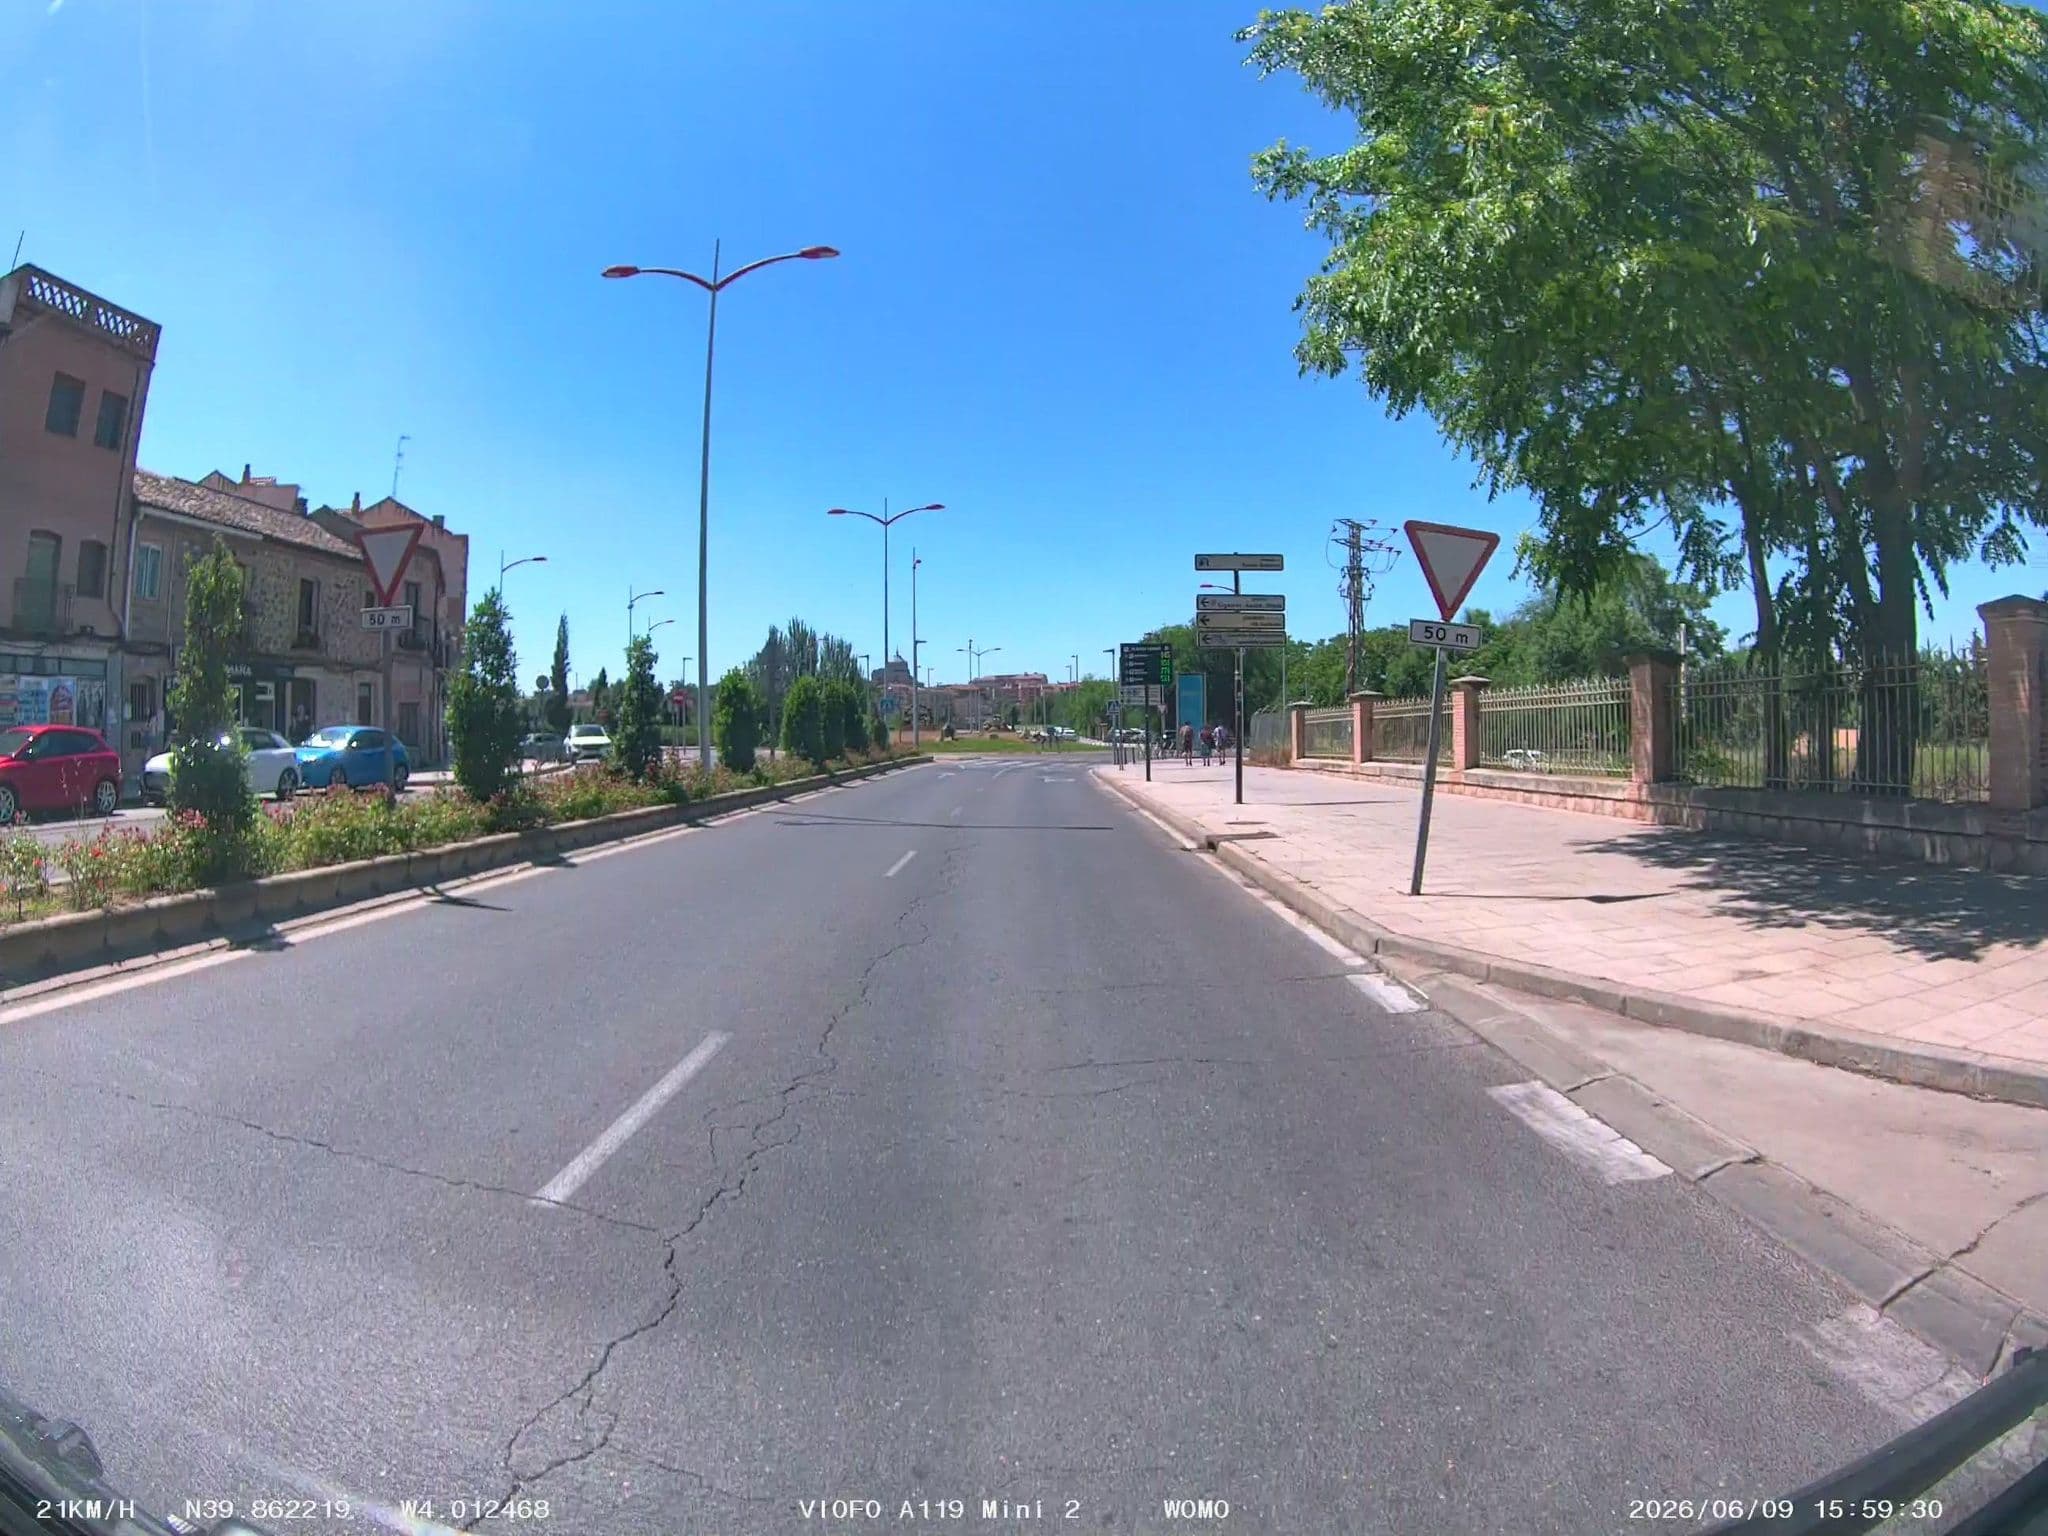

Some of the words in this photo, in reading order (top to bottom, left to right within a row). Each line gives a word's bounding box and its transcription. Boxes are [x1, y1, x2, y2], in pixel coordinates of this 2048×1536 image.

[369, 613, 385, 625] 50
[391, 615, 401, 625] m
[1423, 626, 1446, 642] 50
[1455, 632, 1468, 644] m
